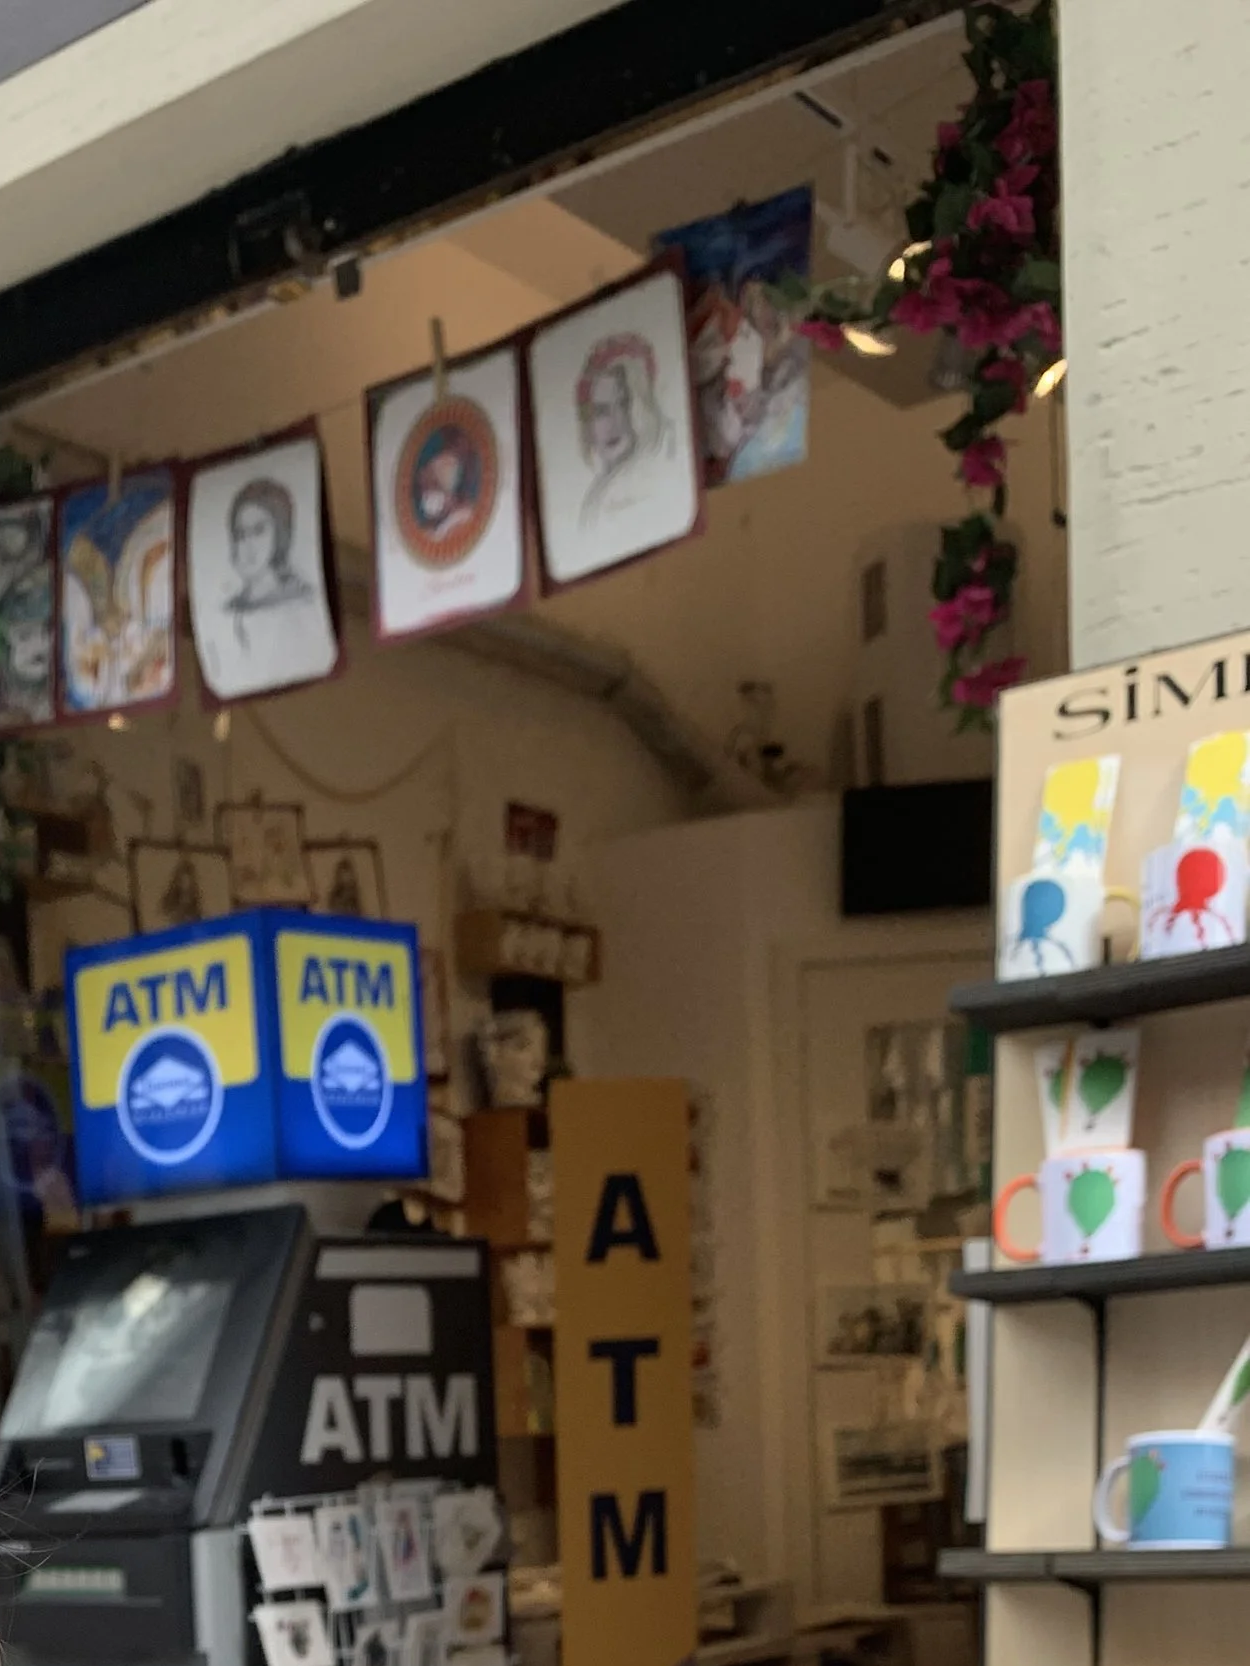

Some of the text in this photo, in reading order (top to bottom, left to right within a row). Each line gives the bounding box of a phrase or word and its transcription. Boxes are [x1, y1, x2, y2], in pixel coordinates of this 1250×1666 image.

[1052, 653, 1250, 741] SiM
[104, 961, 227, 1032] ATM
[301, 957, 394, 1008] ATM
[301, 1373, 478, 1465] ATM
[586, 1173, 669, 1581] ATM
